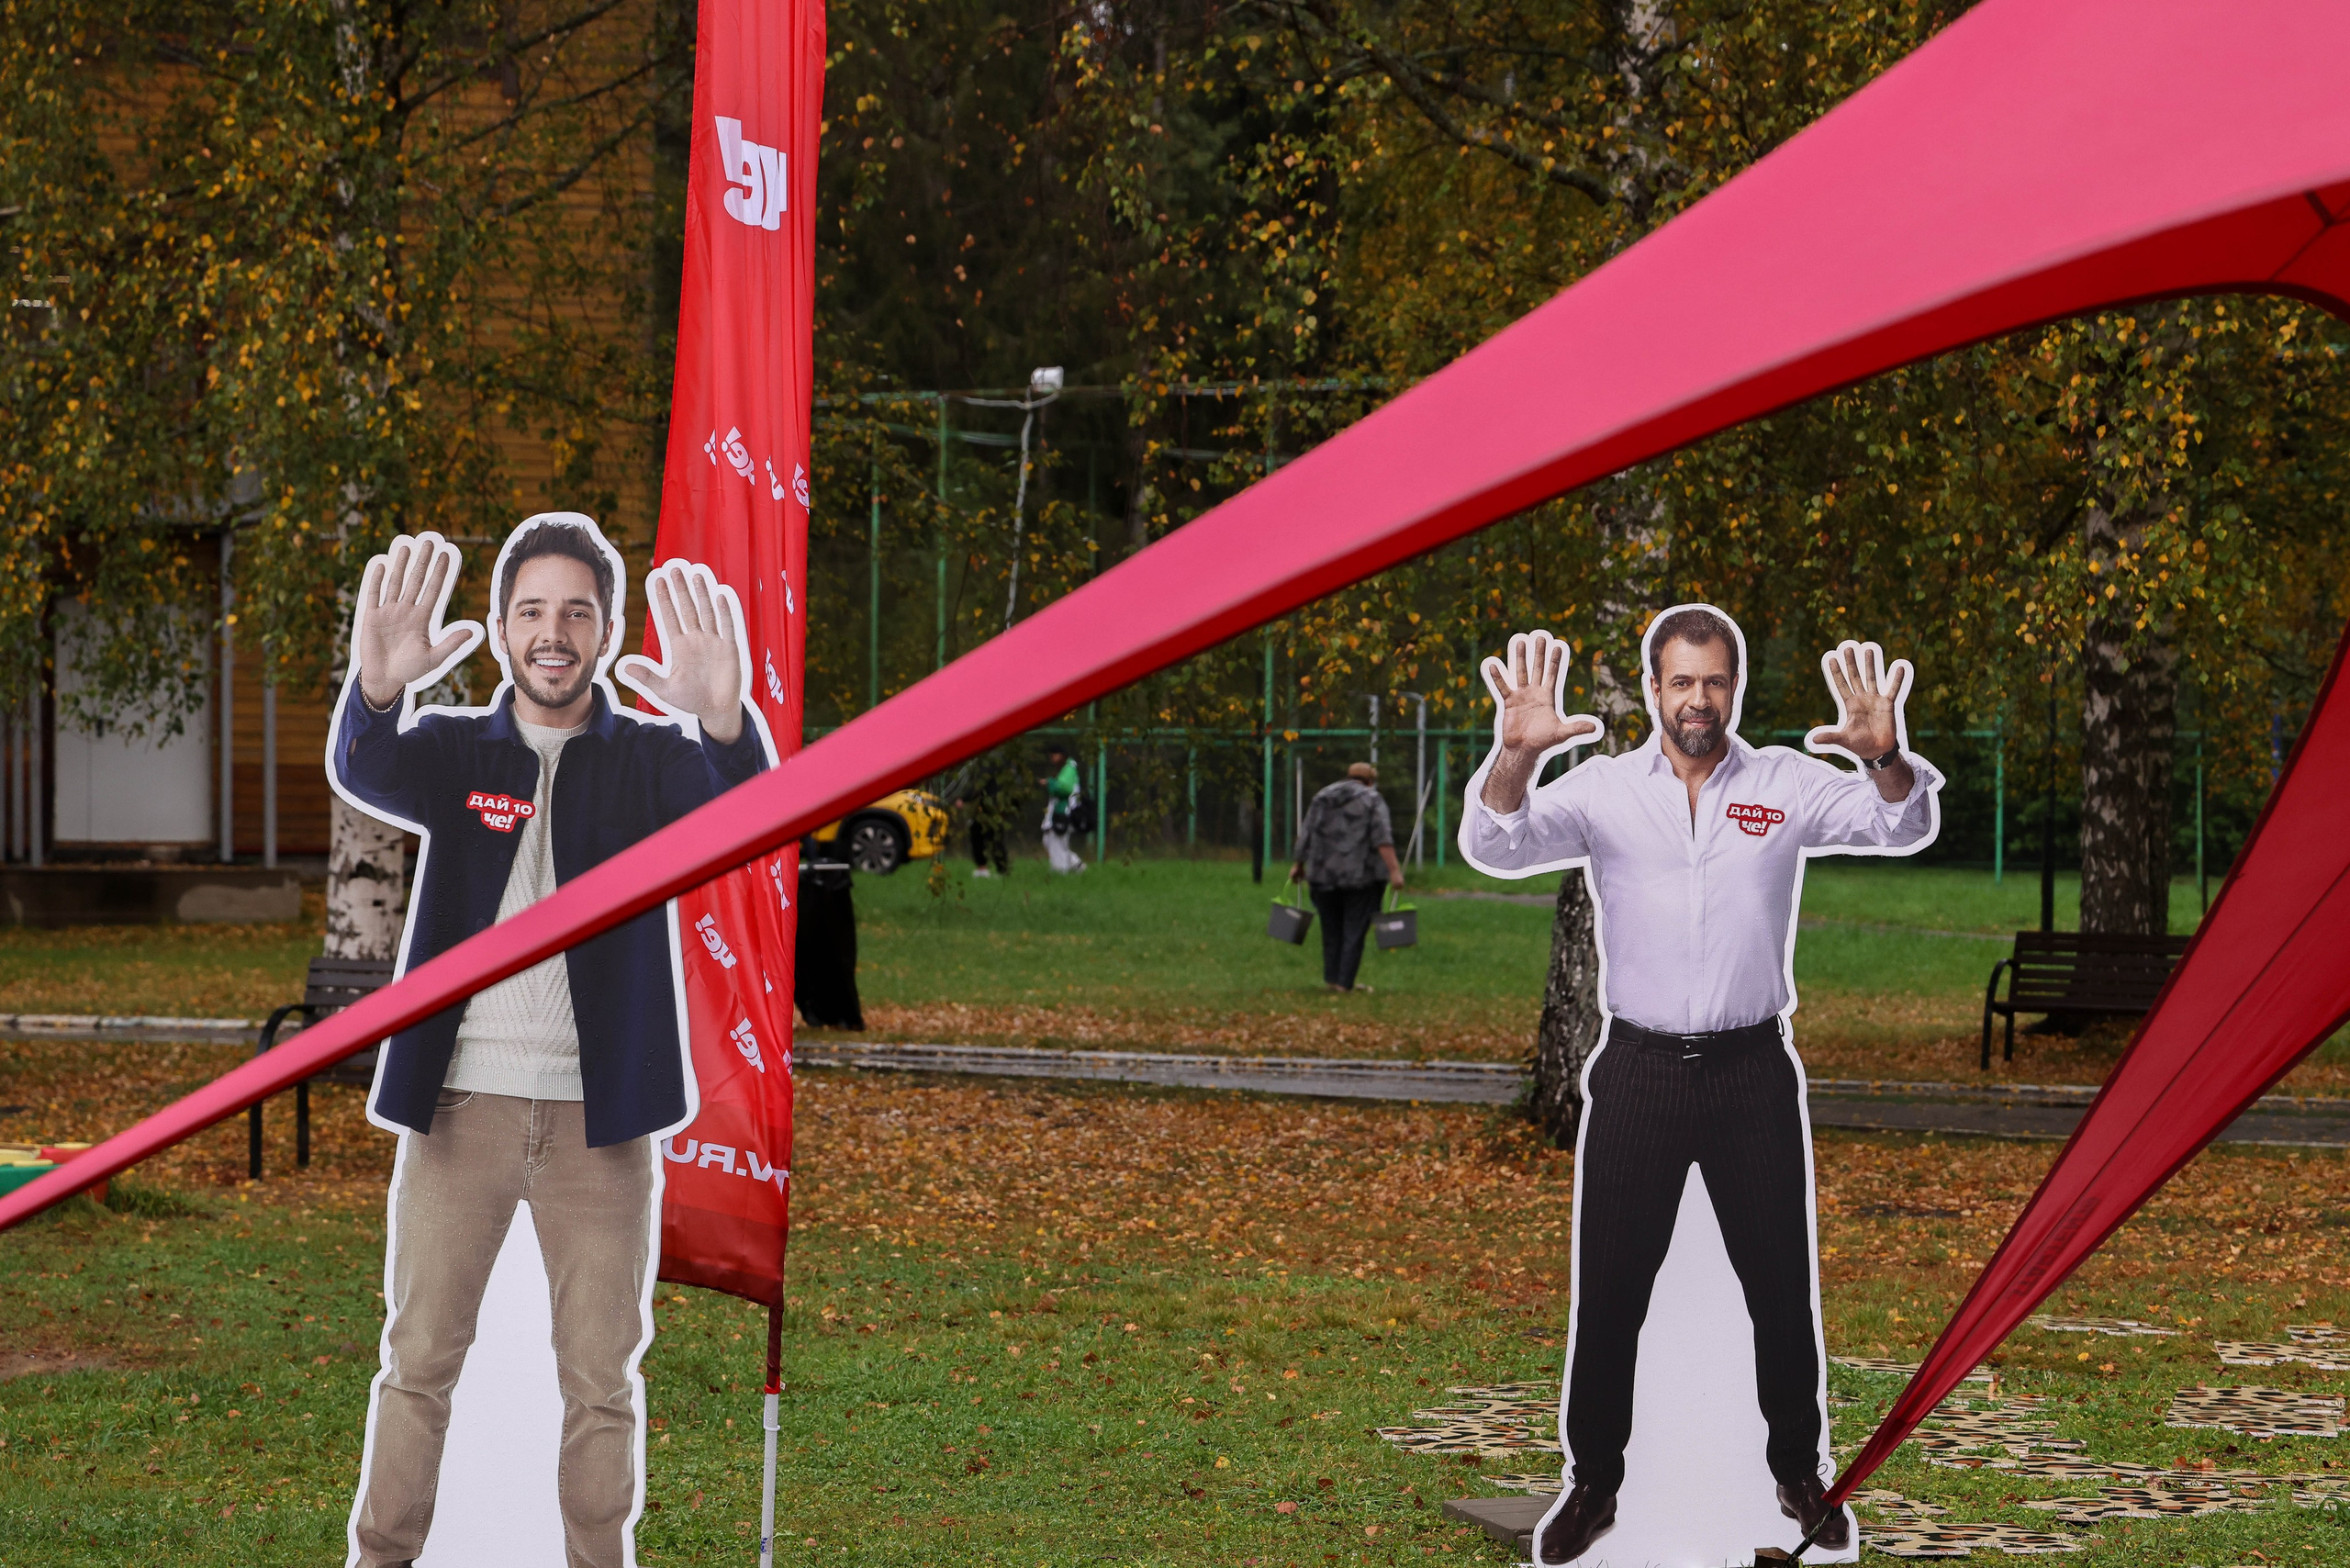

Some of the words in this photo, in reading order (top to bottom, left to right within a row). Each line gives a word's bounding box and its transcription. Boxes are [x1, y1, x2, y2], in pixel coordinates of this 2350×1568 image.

[469, 794, 509, 812] ДАЙ
[513, 803, 532, 815] 10
[483, 812, 515, 830] че!
[1729, 806, 1762, 819] ДАЙ
[1765, 812, 1783, 822] 10
[1741, 820, 1768, 834] че!
